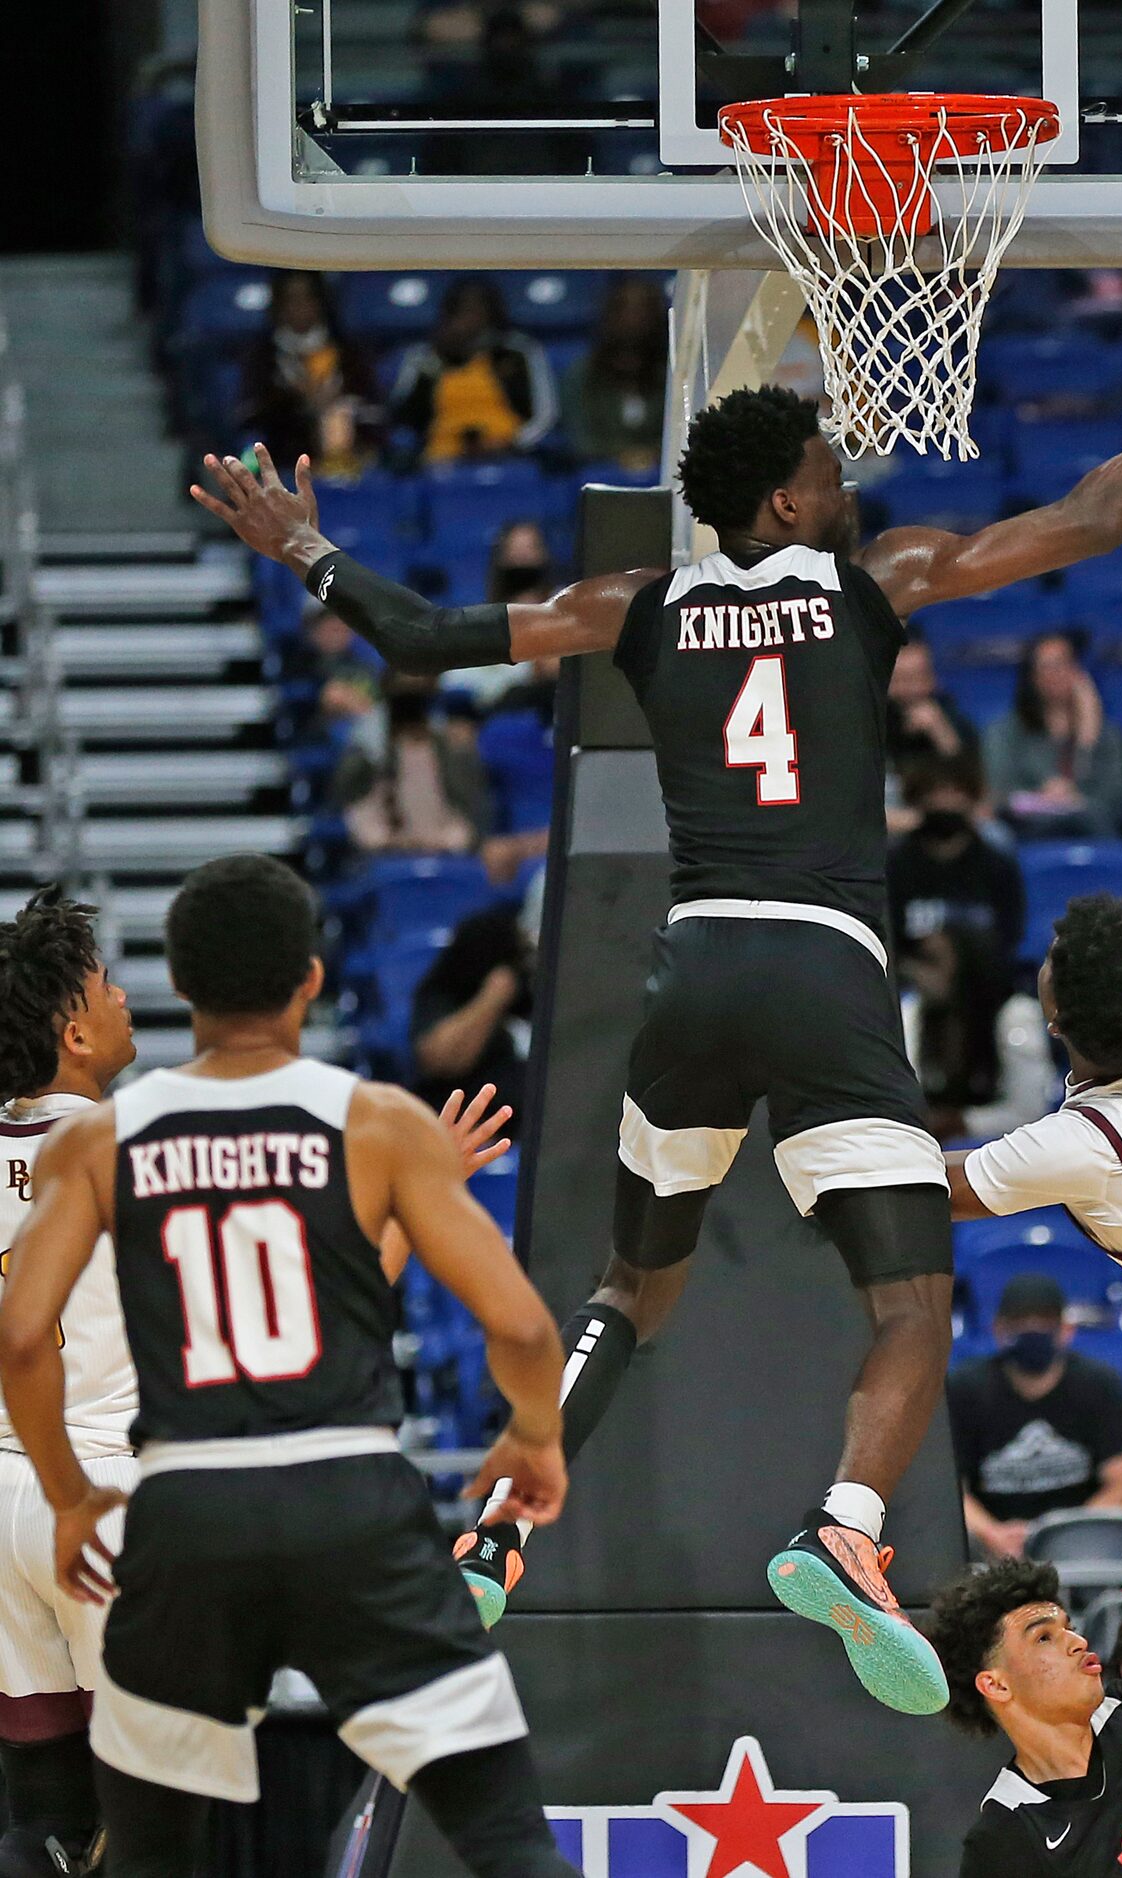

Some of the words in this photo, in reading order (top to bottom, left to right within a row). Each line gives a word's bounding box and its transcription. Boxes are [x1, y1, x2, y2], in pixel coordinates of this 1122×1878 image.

[676, 596, 836, 650] KNIGHTS
[722, 653, 800, 806] 4
[6, 1158, 33, 1202] BU
[128, 1132, 331, 1198] KNIGHTS
[160, 1198, 323, 1389] 10
